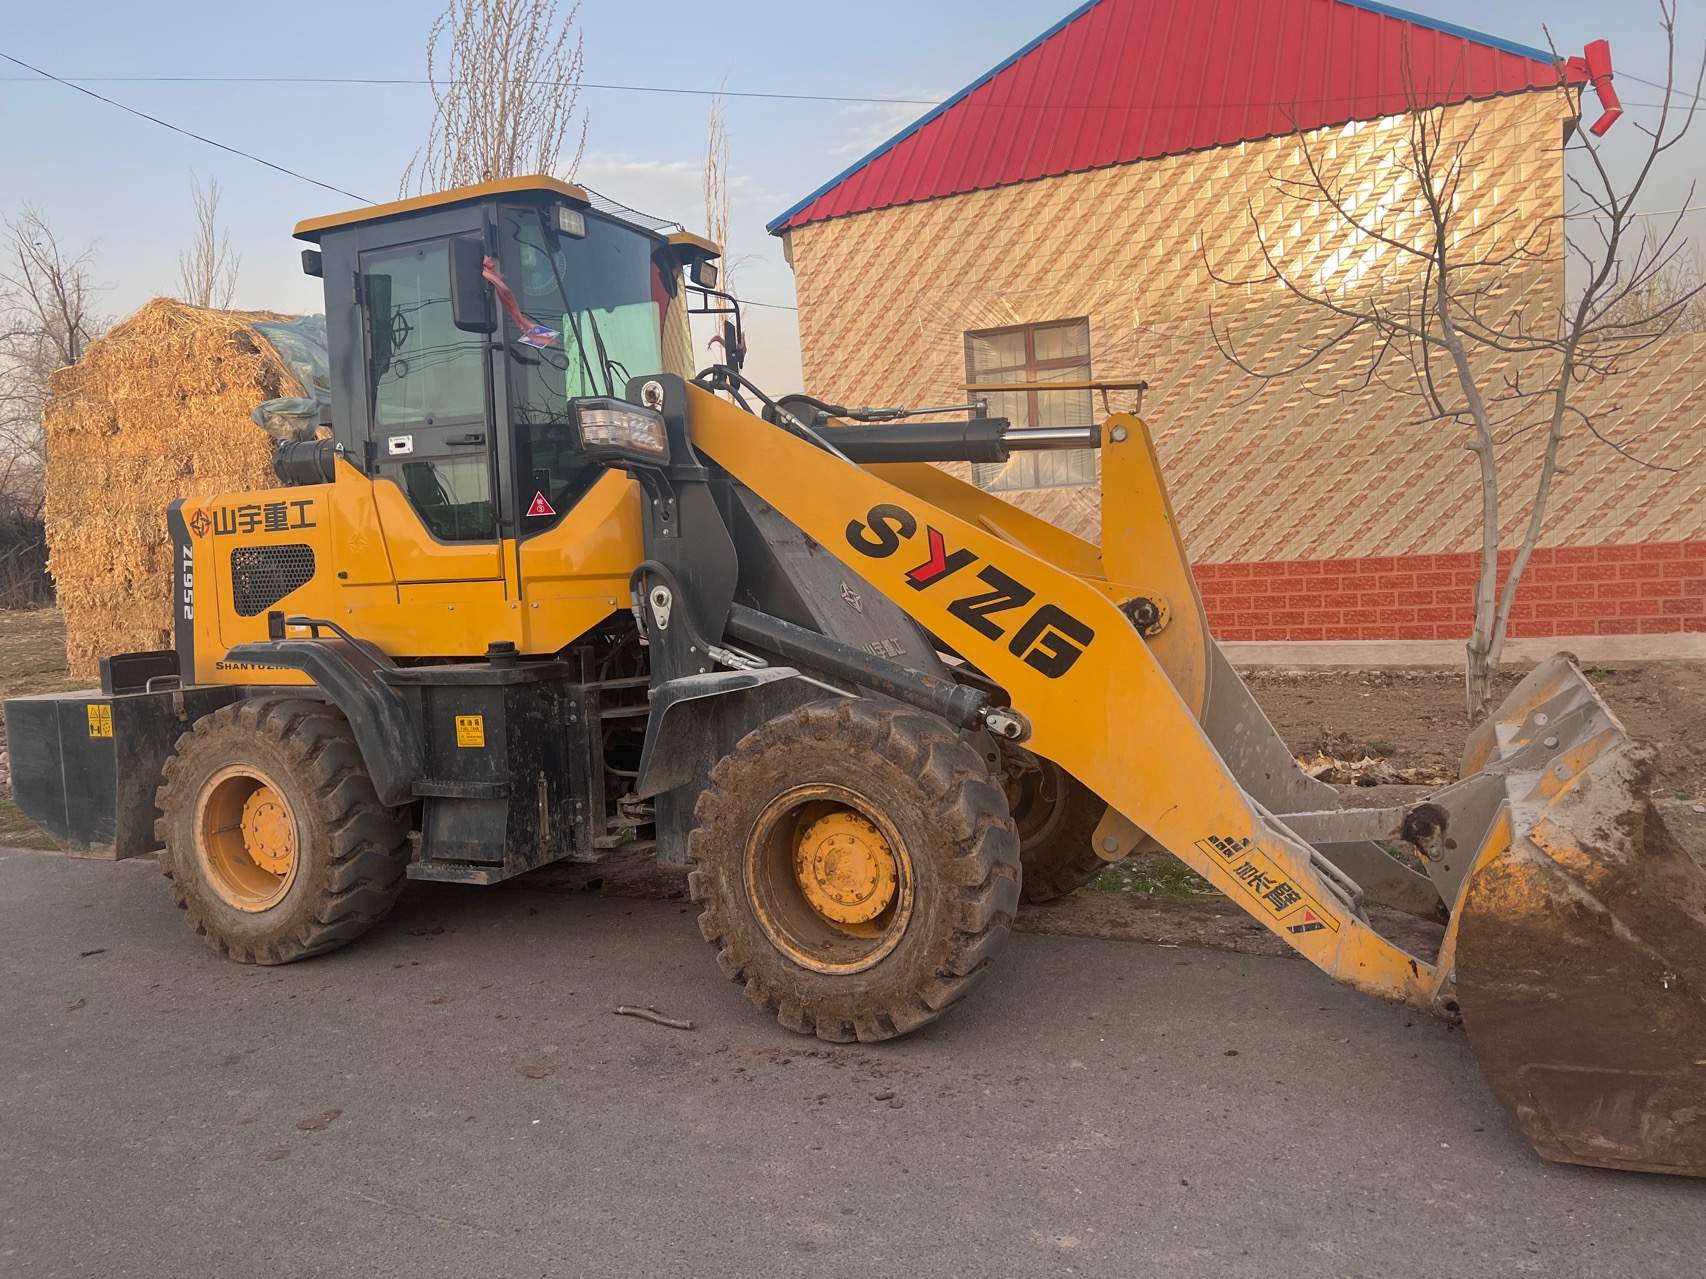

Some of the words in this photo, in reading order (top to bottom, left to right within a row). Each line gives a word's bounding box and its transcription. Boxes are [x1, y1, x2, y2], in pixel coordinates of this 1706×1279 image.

[213, 500, 316, 535] 山宇重工
[183, 545, 194, 620] ZL952
[845, 503, 1096, 679] SYZG
[1233, 862, 1302, 912] 加长臂
